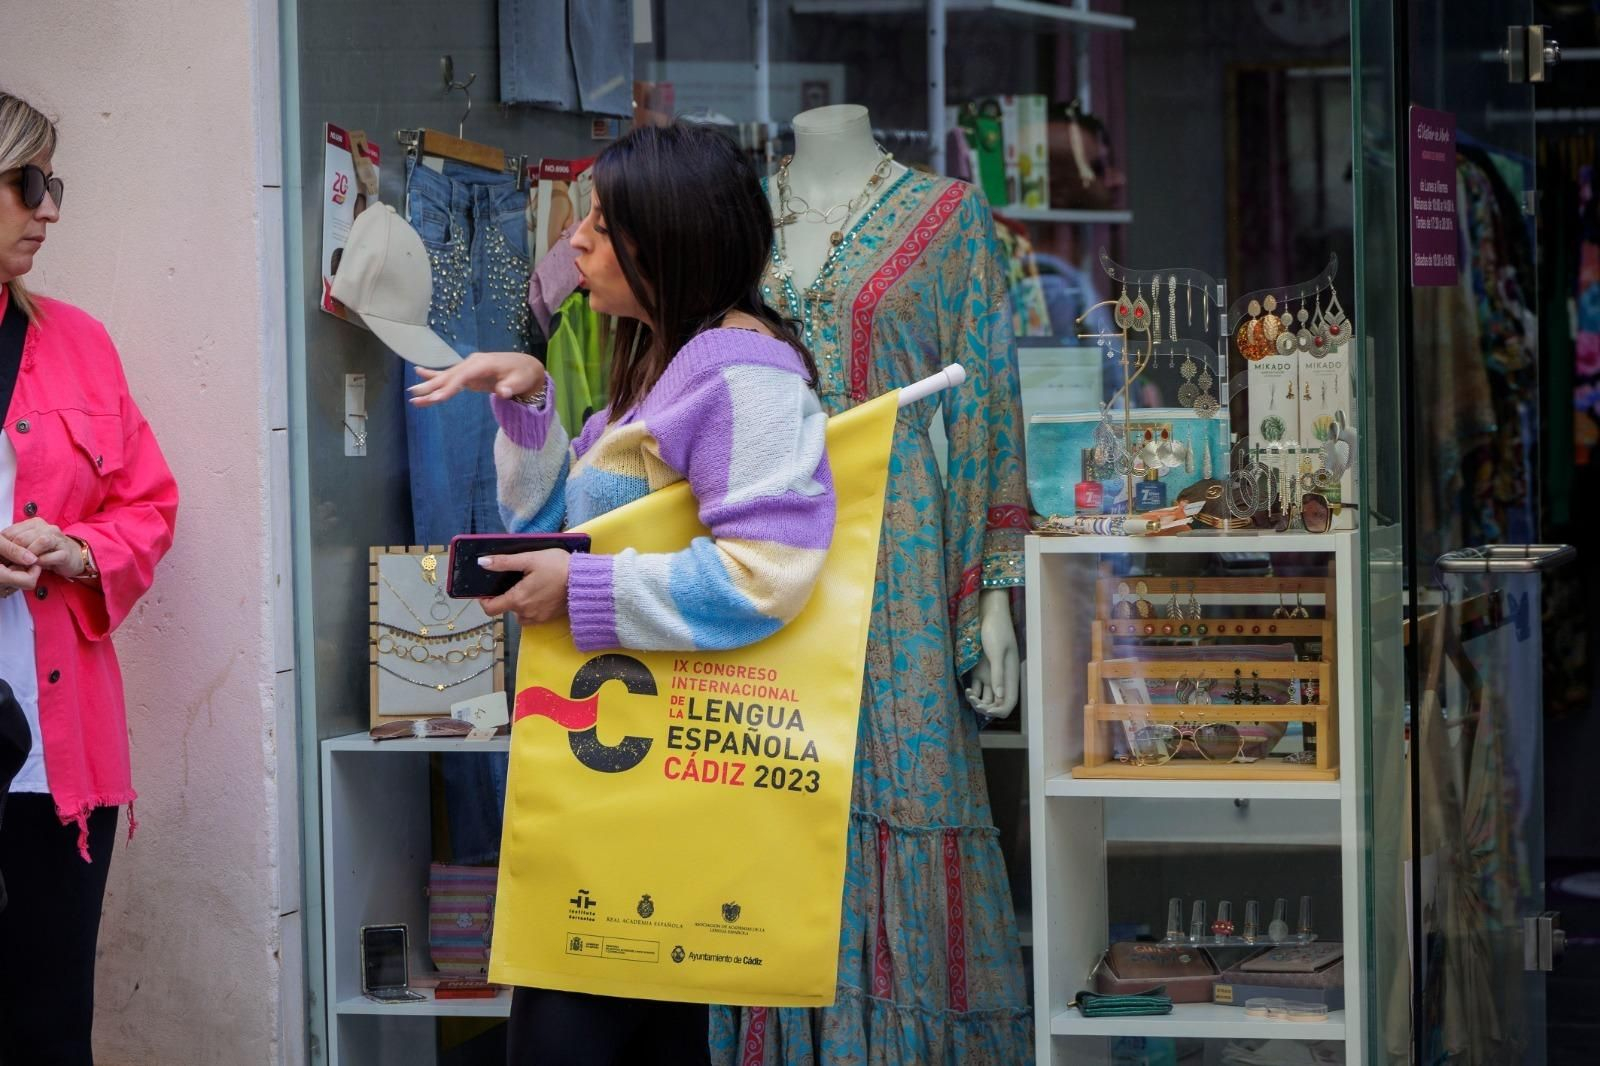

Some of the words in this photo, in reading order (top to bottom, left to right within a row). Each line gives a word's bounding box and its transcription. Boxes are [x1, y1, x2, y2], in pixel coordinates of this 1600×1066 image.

[1305, 361, 1342, 369] MIKADO
[673, 659, 689, 674] IX
[693, 662, 778, 682] CONGRESO
[670, 695, 685, 706] DE
[671, 677, 800, 702] INTERNACIONAL
[669, 708, 684, 720] LA
[688, 697, 804, 732] LENGUA
[667, 725, 820, 763] ESPAÑOLA
[663, 751, 746, 787] CÁDIZ
[753, 764, 820, 793] 2023
[623, 918, 652, 926] ACADEMIA
[654, 921, 684, 929] ESPAÑOLA
[688, 951, 733, 963] Ayuntamiento
[733, 955, 742, 964] de
[743, 956, 763, 966] Cádiz
